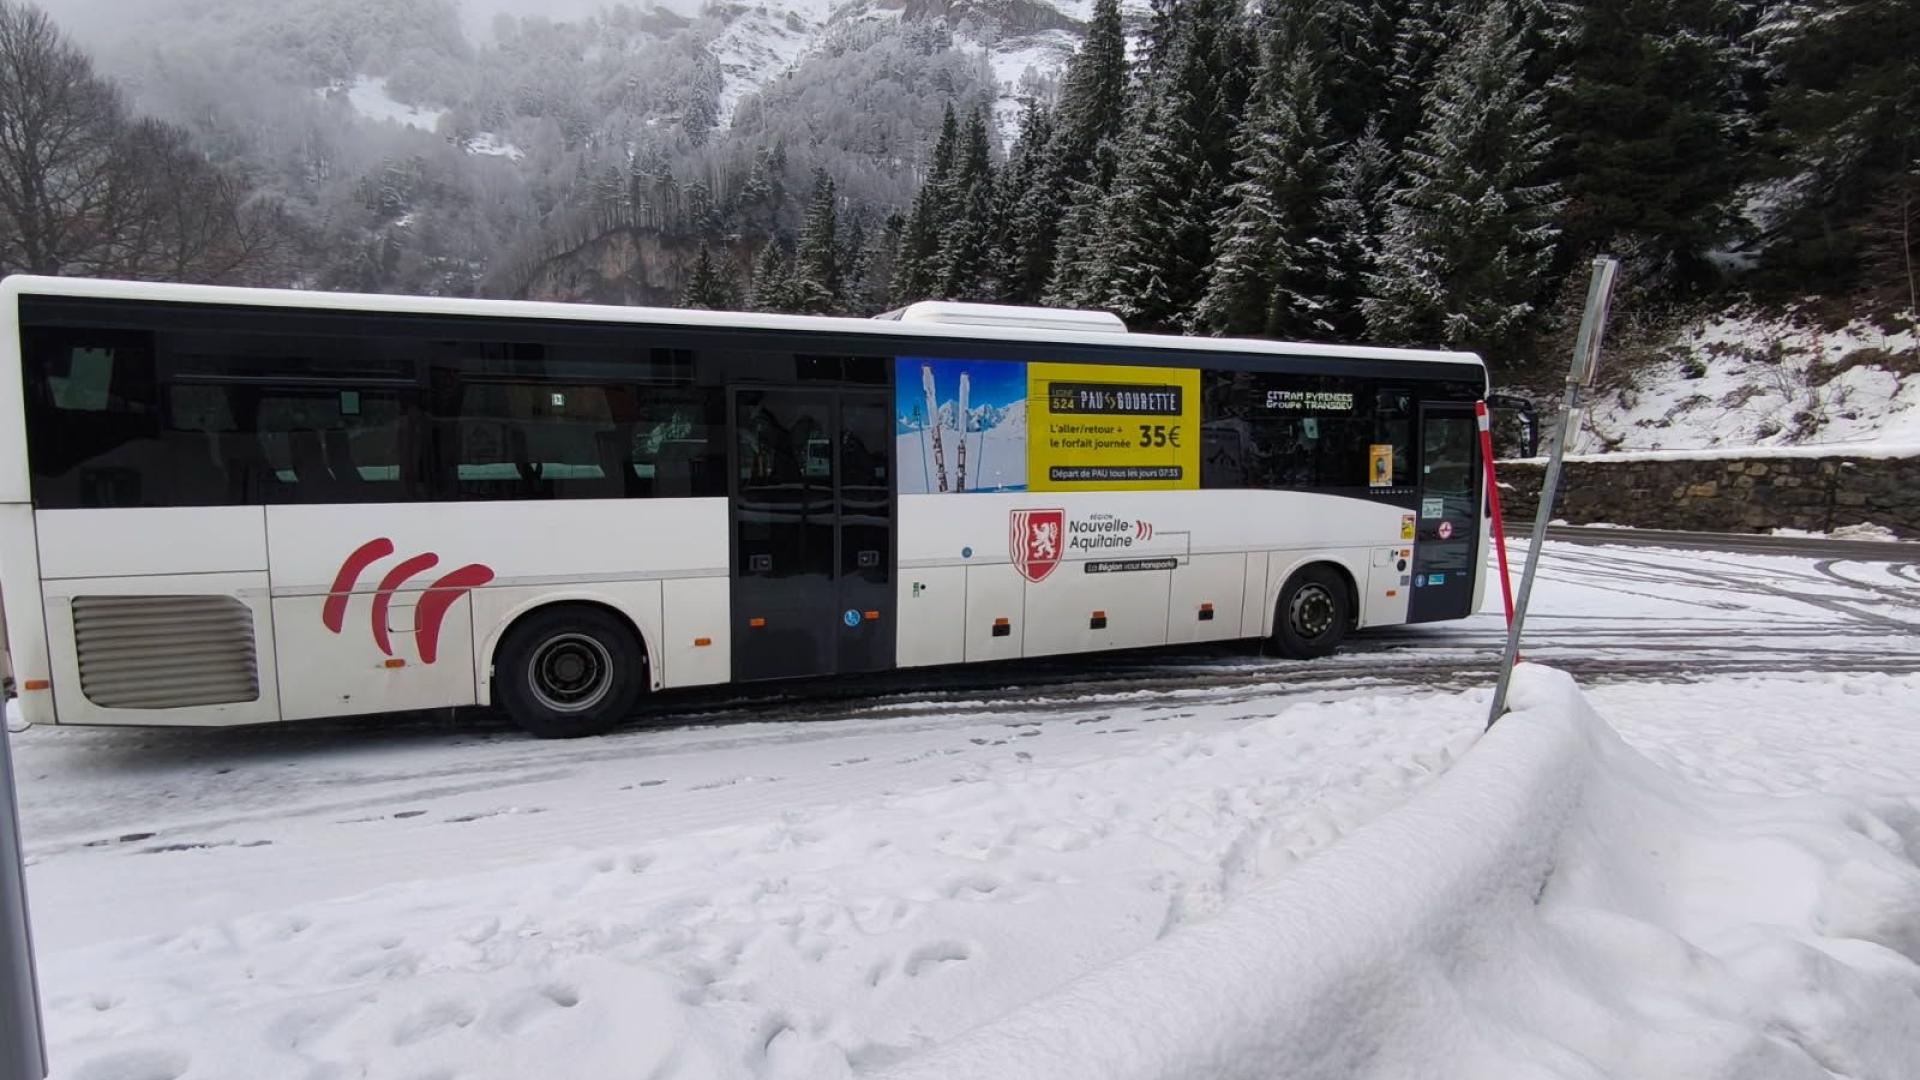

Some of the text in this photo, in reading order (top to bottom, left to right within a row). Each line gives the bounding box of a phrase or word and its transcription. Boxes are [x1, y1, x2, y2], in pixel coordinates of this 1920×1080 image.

[1053, 398, 1075, 409] 524
[1080, 391, 1103, 409] PAU
[1267, 390, 1304, 400] CITRAM
[1266, 400, 1353, 410] Groupe TRANSDEV
[1139, 425, 1181, 448] 35€
[1050, 438, 1131, 450] le forfait journée
[1052, 469, 1078, 479] Départ
[1080, 470, 1090, 478] de
[1092, 469, 1108, 477] PAU
[1110, 469, 1126, 478] tous
[1127, 469, 1138, 478] les
[1139, 469, 1157, 479] jours
[1069, 519, 1133, 533] Nouvelle-
[1069, 534, 1132, 552] Aquitaine
